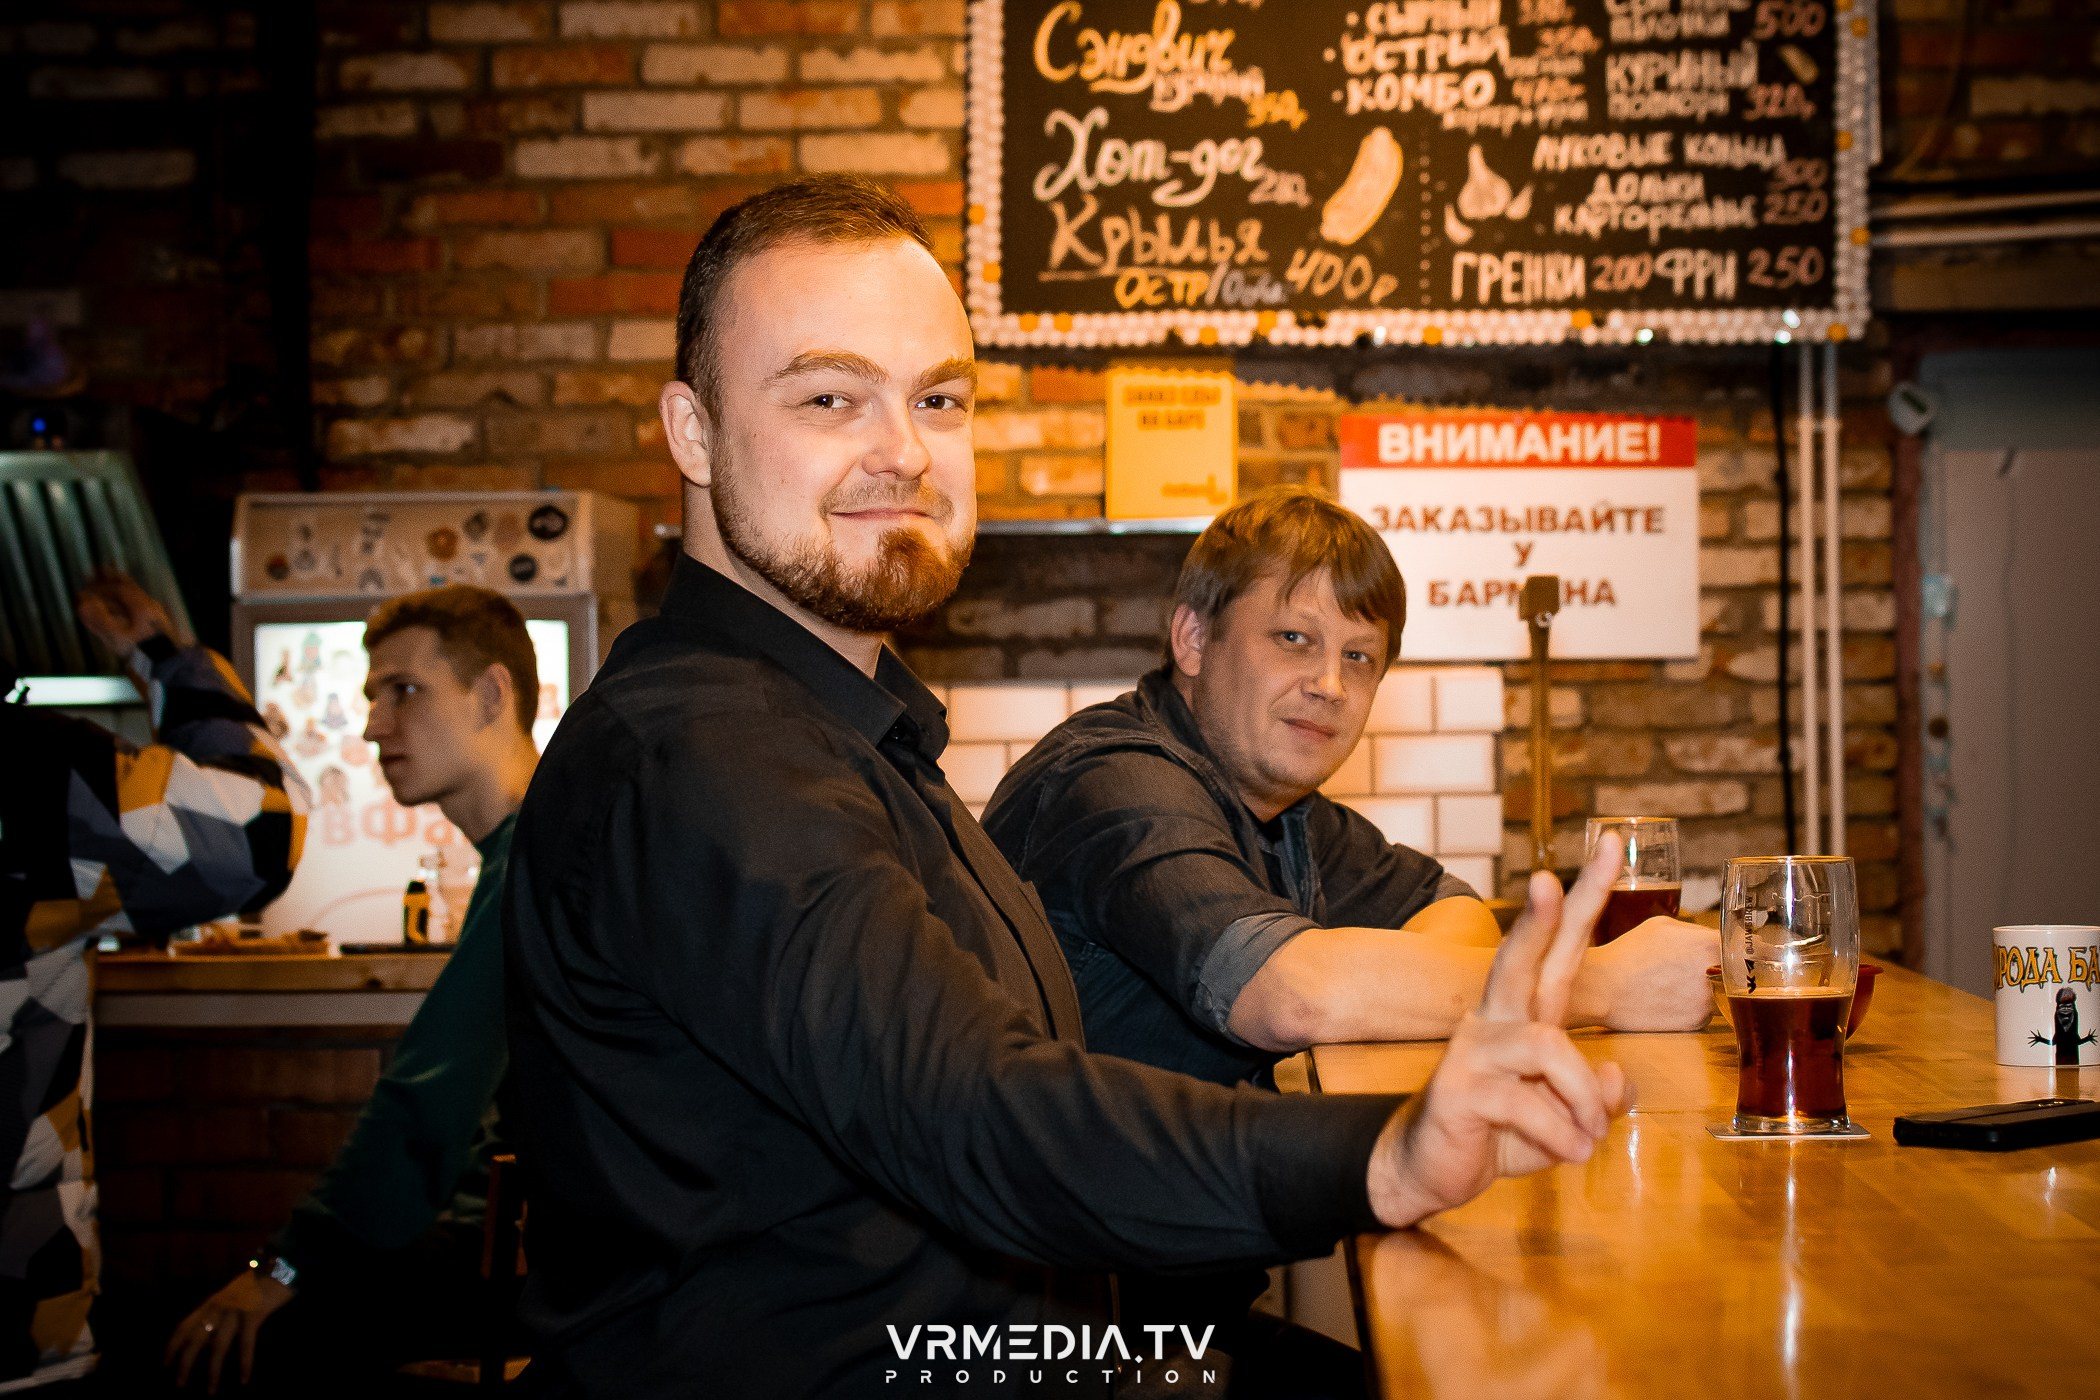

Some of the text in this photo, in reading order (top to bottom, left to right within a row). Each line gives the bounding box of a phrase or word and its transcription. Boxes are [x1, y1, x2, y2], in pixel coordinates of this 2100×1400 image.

[1752, 3, 1826, 40] 500
[1346, 69, 1497, 115] КОМБО
[1451, 250, 1586, 303] ГРЕНКИ
[1655, 247, 1737, 300] ФРИ
[1746, 246, 1825, 289] 250
[1377, 422, 1661, 463] ВНИМАНИЕ!
[1371, 501, 1665, 534] ЗАКАЗЫВАЙТЕ
[1512, 540, 1536, 567] У
[1427, 578, 1617, 606] БАРМНА
